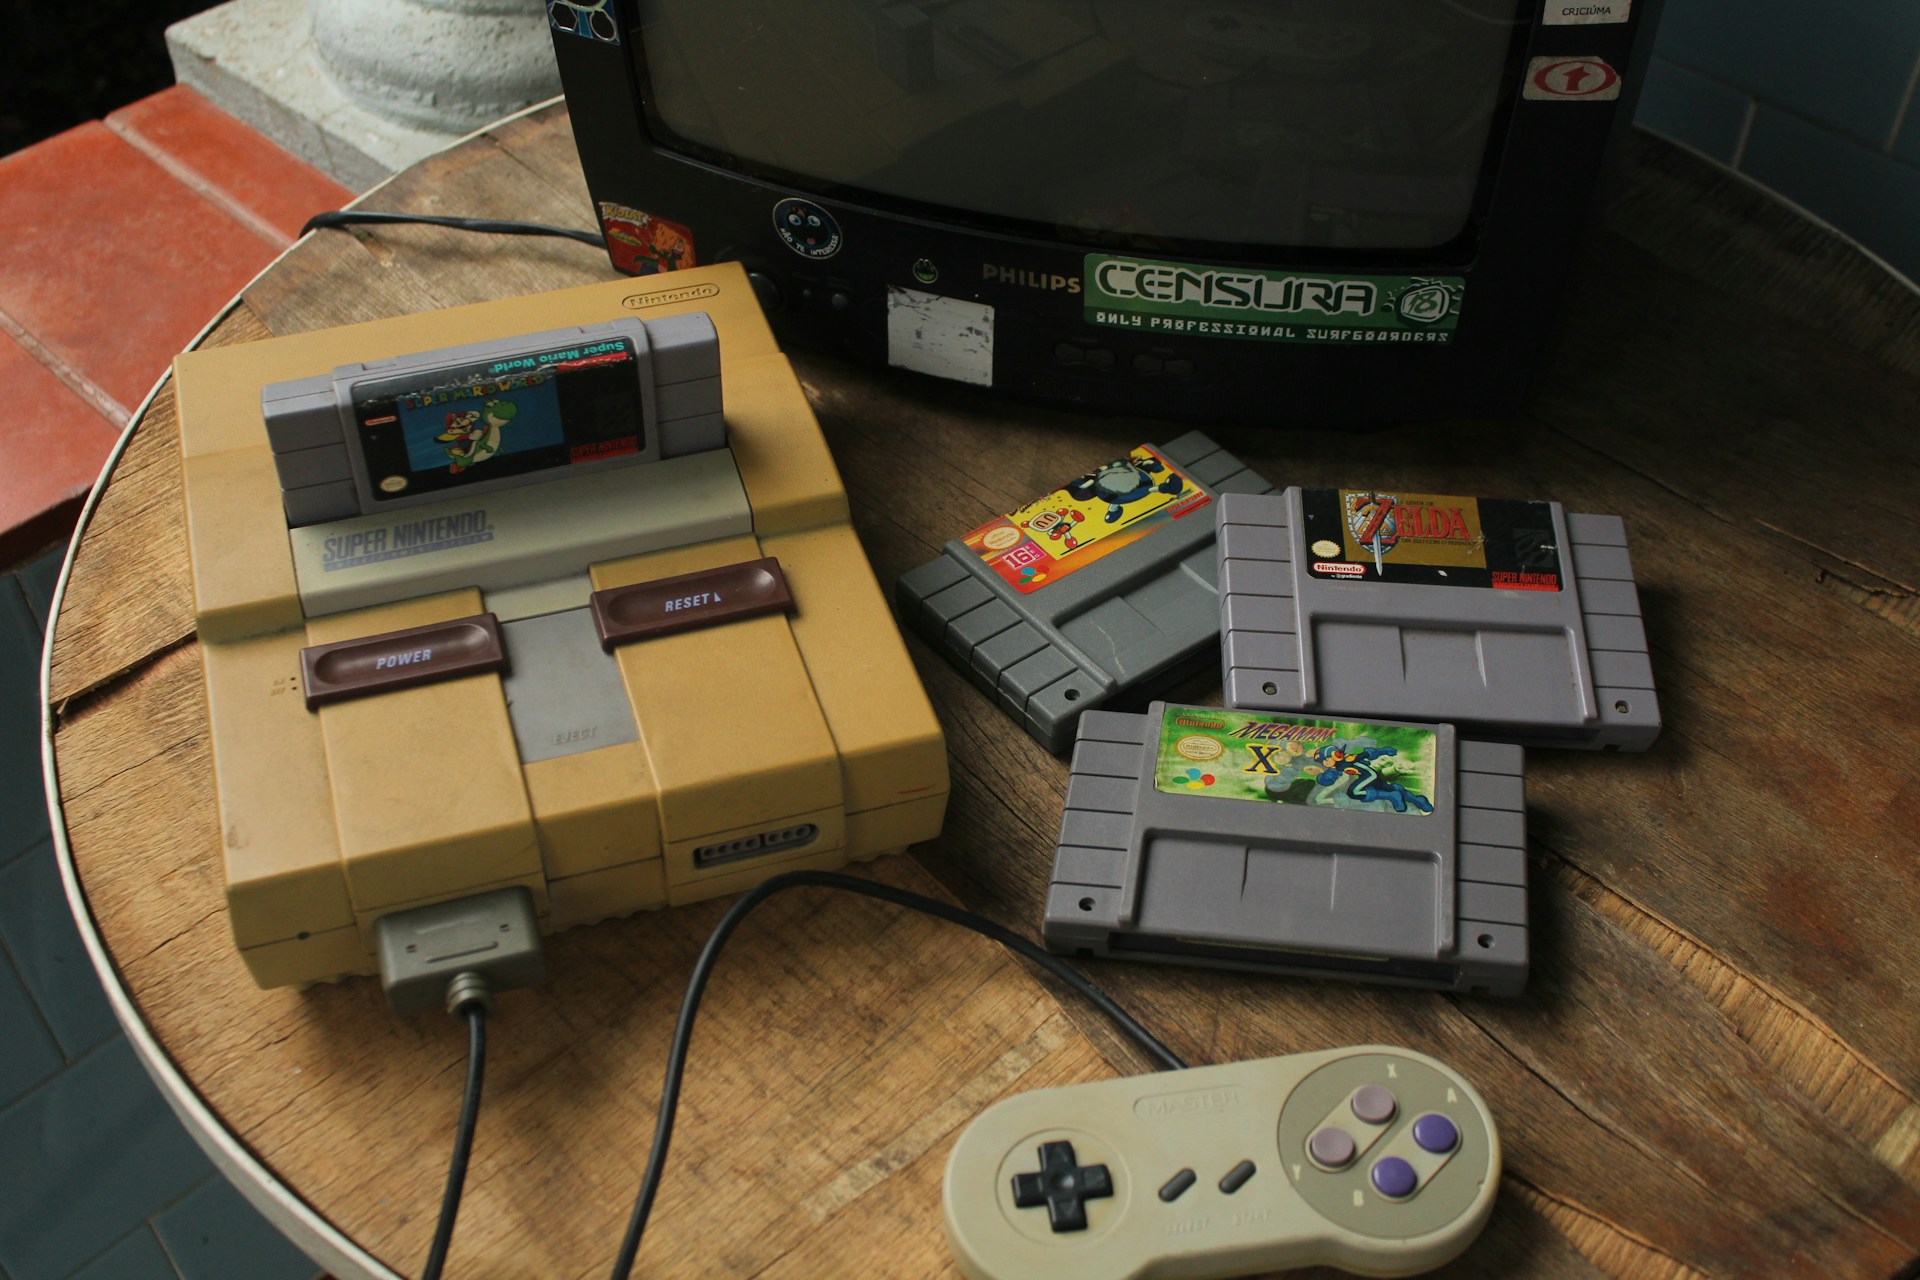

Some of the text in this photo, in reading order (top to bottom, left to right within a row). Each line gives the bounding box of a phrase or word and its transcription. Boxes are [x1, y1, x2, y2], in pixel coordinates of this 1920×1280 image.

[1562, 4, 1611, 16] CRICIÚMA
[982, 262, 1082, 295] PHILIPS
[1096, 261, 1376, 316] CENSURA
[630, 287, 713, 307] Nintendo
[1408, 290, 1438, 314] 18
[1096, 311, 1449, 342] ONLY PROFESSIONAL SURFBOARDERS
[539, 350, 580, 364] Mario
[583, 341, 625, 356] Super
[1355, 497, 1472, 545] ZELDA
[323, 509, 487, 563] SUPER NINTENDO
[1005, 549, 1033, 569] 16
[1317, 564, 1362, 573] Nintendo
[1491, 570, 1558, 585] SUPER NINTENDO
[664, 592, 710, 613] RESET
[376, 649, 432, 670] POWER
[552, 726, 597, 746] EJECT
[1228, 721, 1338, 743] MEGAMAN
[1243, 743, 1280, 775] X
[1387, 1063, 1397, 1079] X
[1447, 1087, 1458, 1103] A
[1292, 1164, 1302, 1181] Y
[1353, 1189, 1364, 1207] B
